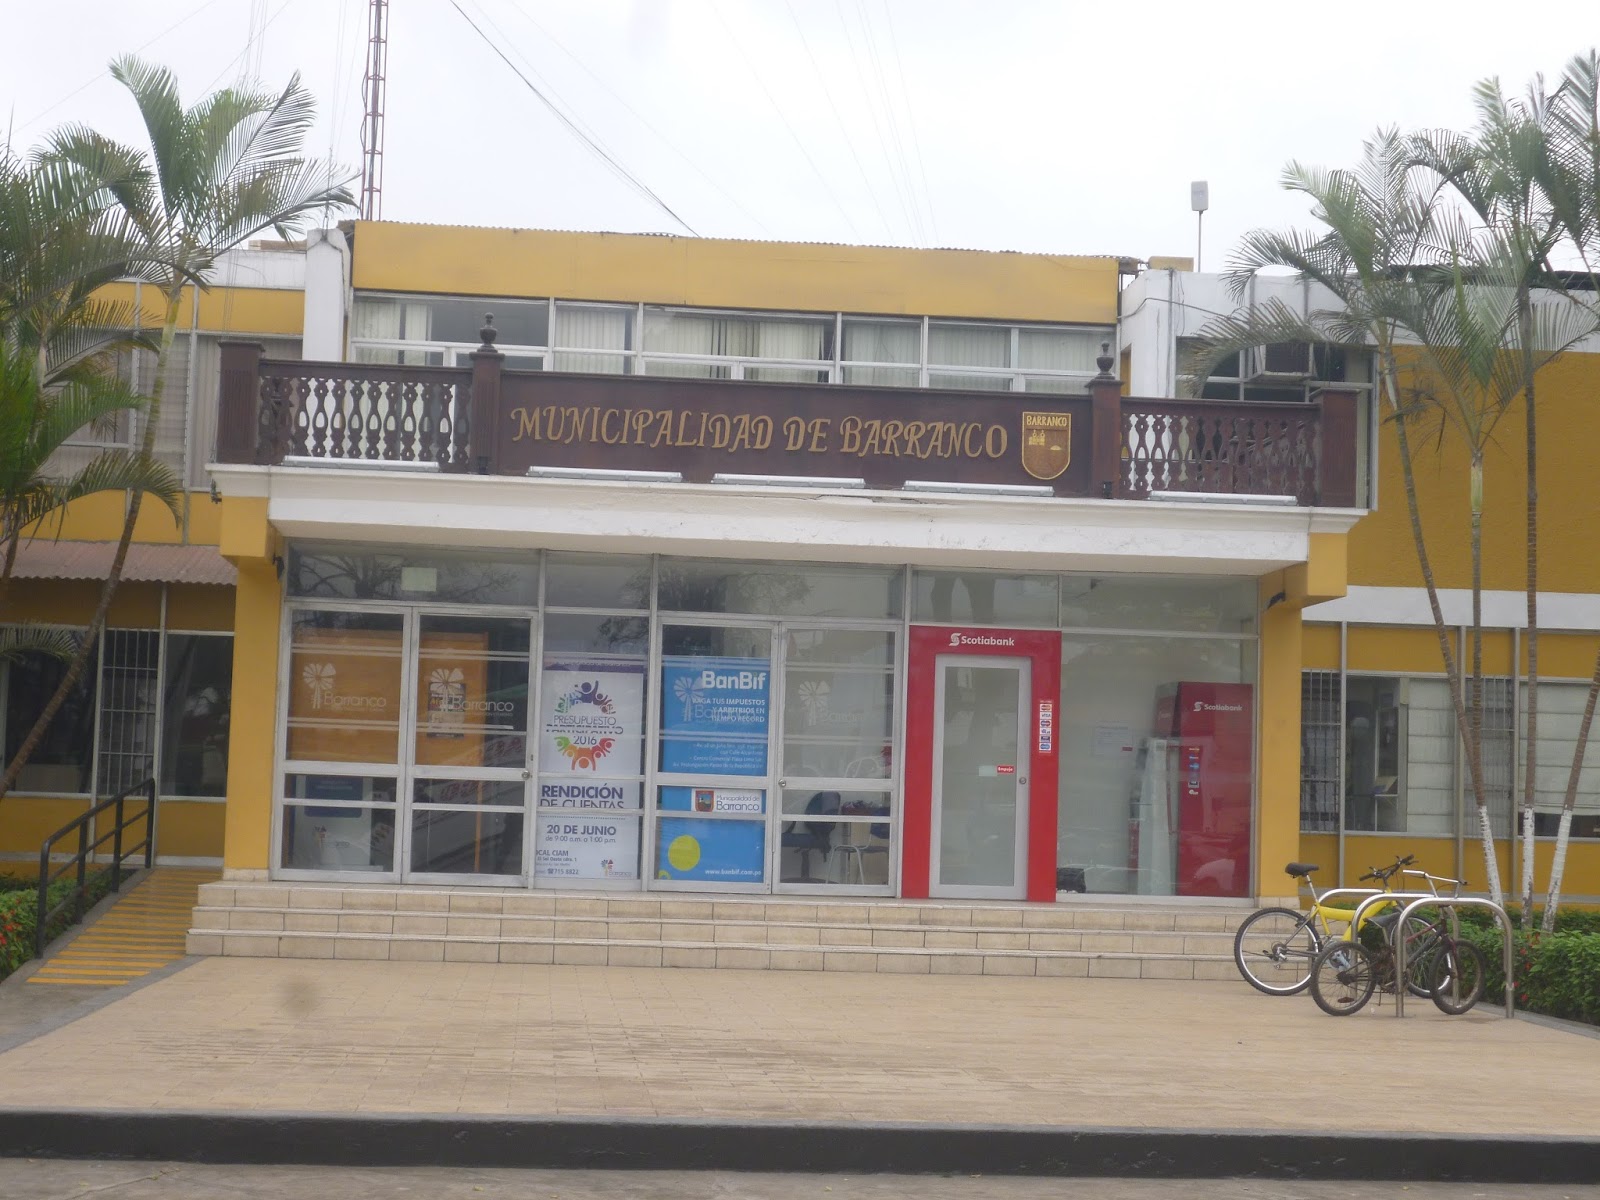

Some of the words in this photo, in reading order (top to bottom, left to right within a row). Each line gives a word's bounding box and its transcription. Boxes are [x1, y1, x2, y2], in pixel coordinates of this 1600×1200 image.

[1026, 415, 1067, 427] BARRANCO
[511, 406, 773, 452] MUNICIPALIDAD
[783, 416, 830, 452] DE
[840, 416, 1008, 459] BARRANCO
[961, 635, 1015, 646] Scotiabank
[702, 670, 767, 690] BanBif
[453, 695, 514, 712] Barranco
[726, 698, 766, 706] IMPUESTOS
[1204, 703, 1243, 711] Scotiabank
[554, 714, 617, 725] PRESUPUESTO
[573, 735, 597, 745] 2016
[541, 783, 623, 799] RENDICIÓN
[716, 800, 760, 811] Barranco
[547, 824, 560, 834] 20
[564, 825, 578, 834] DE
[581, 825, 617, 836] JUNIO
